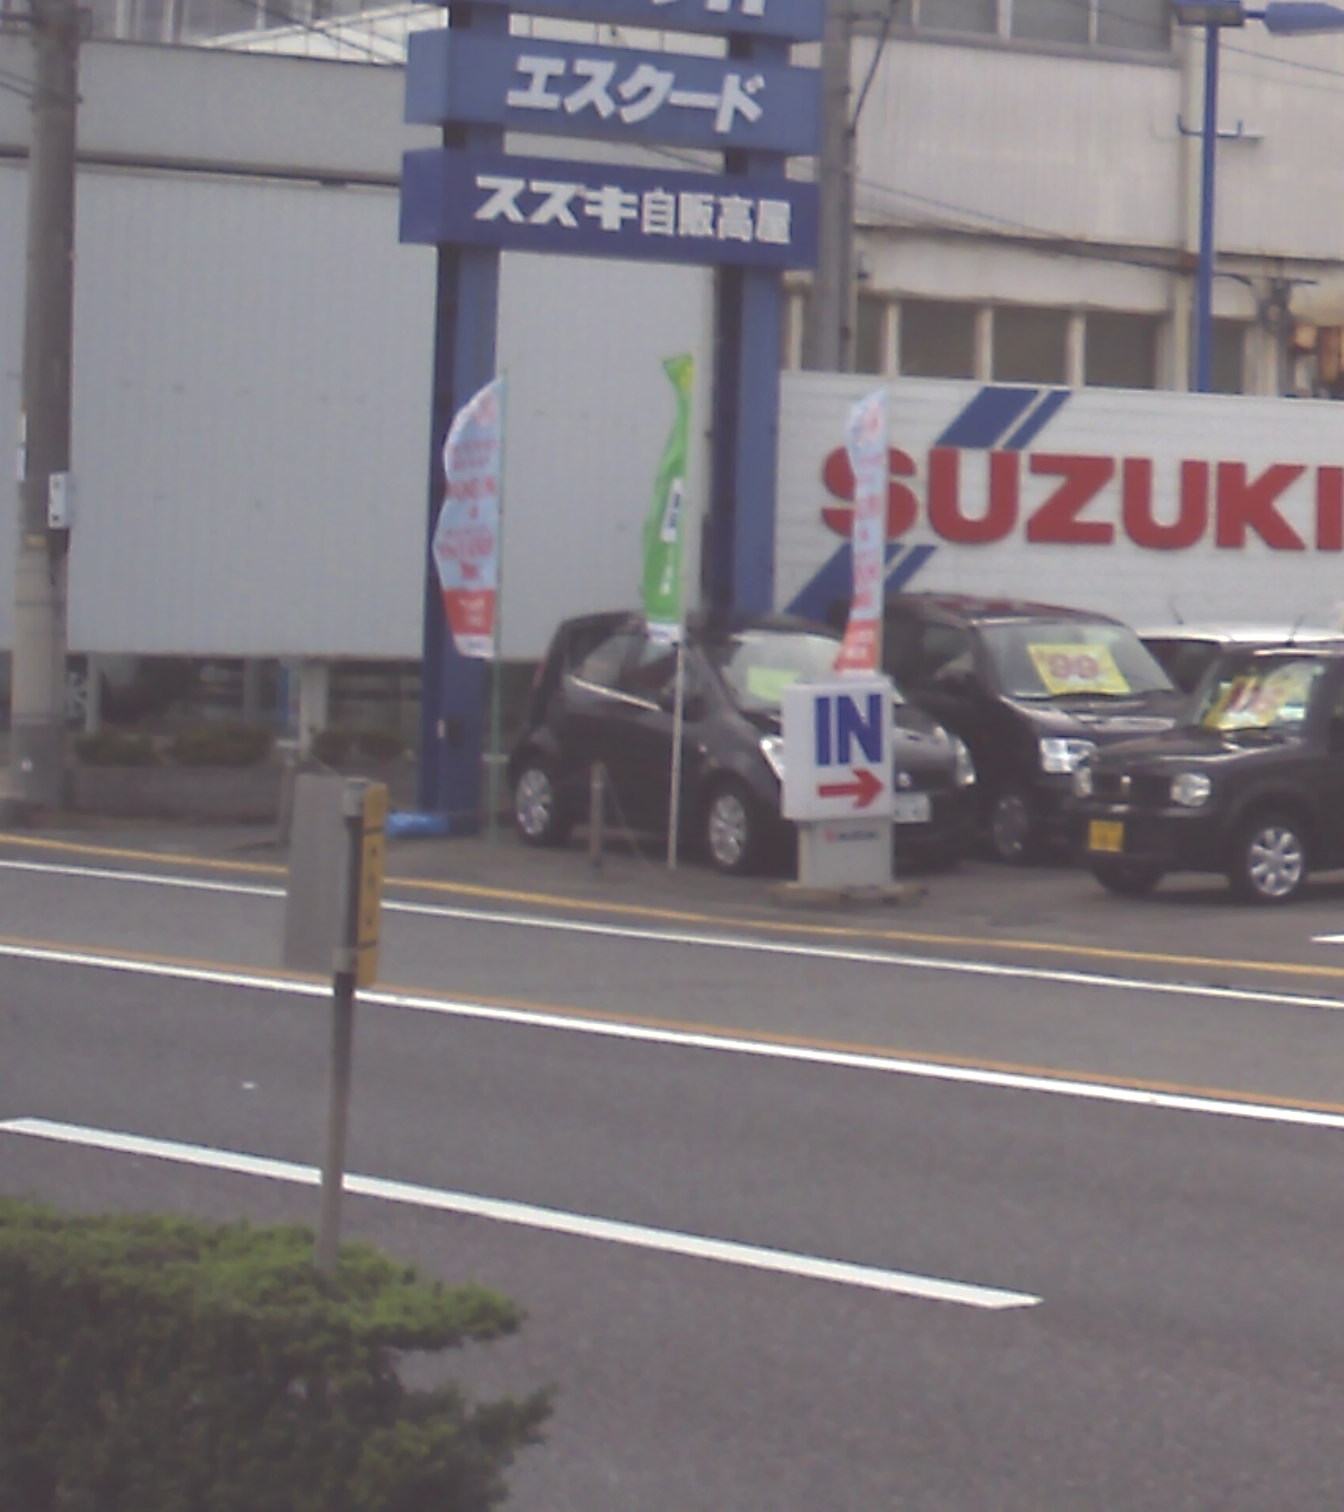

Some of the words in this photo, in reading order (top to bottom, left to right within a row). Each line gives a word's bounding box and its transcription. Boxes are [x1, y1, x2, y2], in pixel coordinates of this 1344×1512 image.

[507, 54, 766, 134] エスクード
[815, 694, 884, 766] IN
